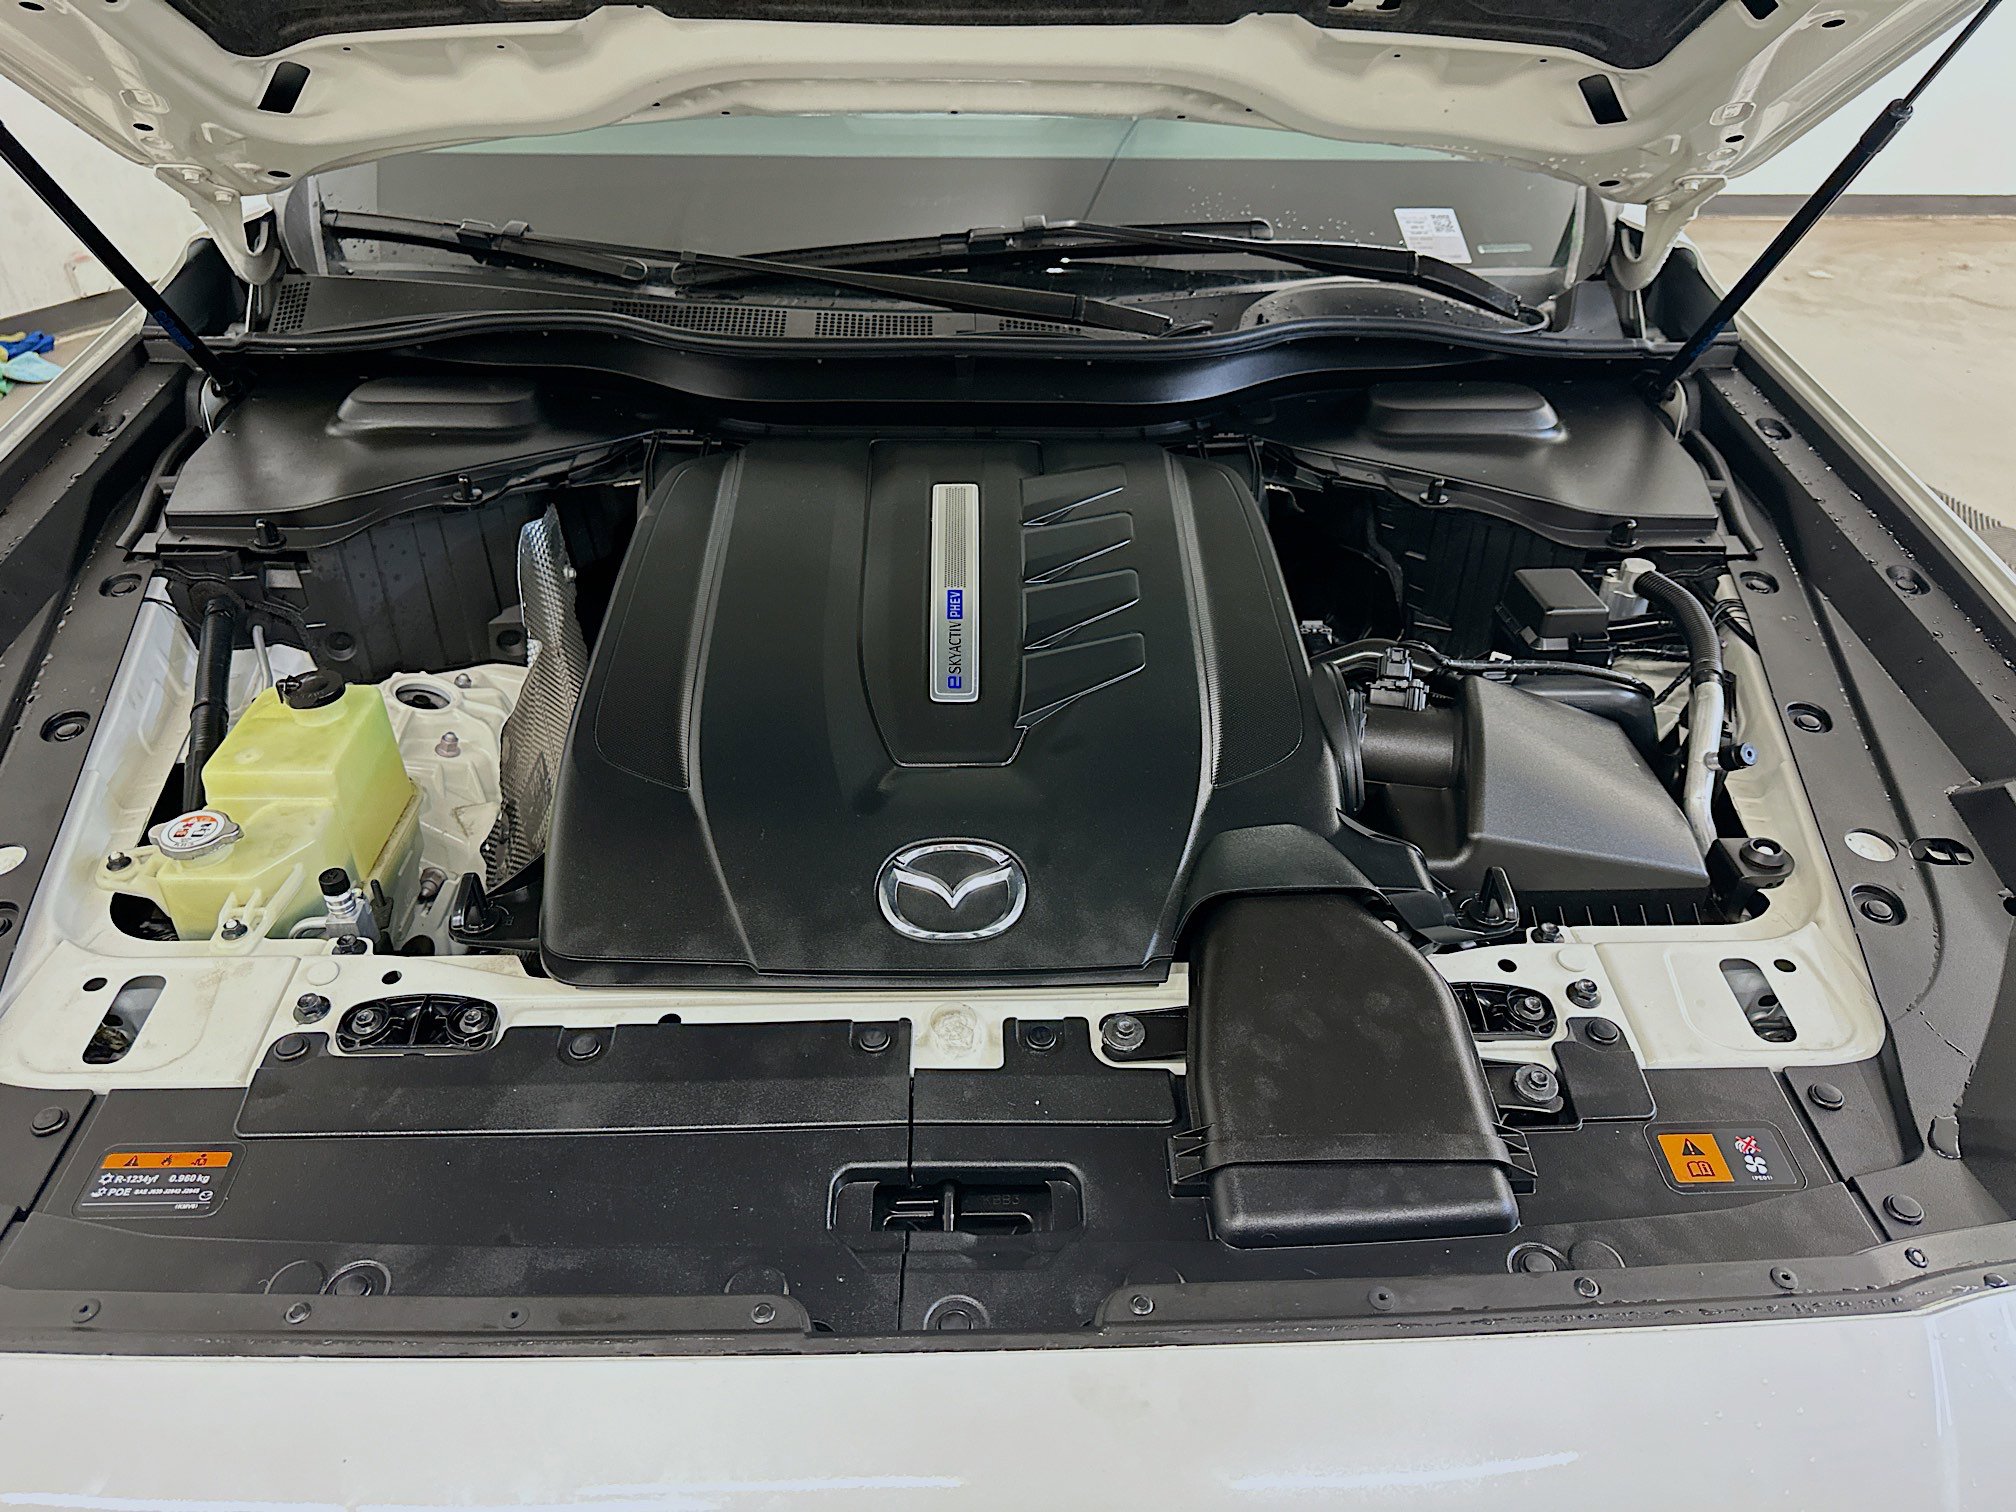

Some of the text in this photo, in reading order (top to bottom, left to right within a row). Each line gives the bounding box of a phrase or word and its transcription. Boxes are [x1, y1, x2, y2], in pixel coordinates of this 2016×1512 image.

[950, 591, 961, 618] PHEV
[948, 621, 962, 675] SKYACTIV
[115, 1174, 210, 1184] R-1234yf 0.960 kg
[107, 1188, 132, 1196] POE
